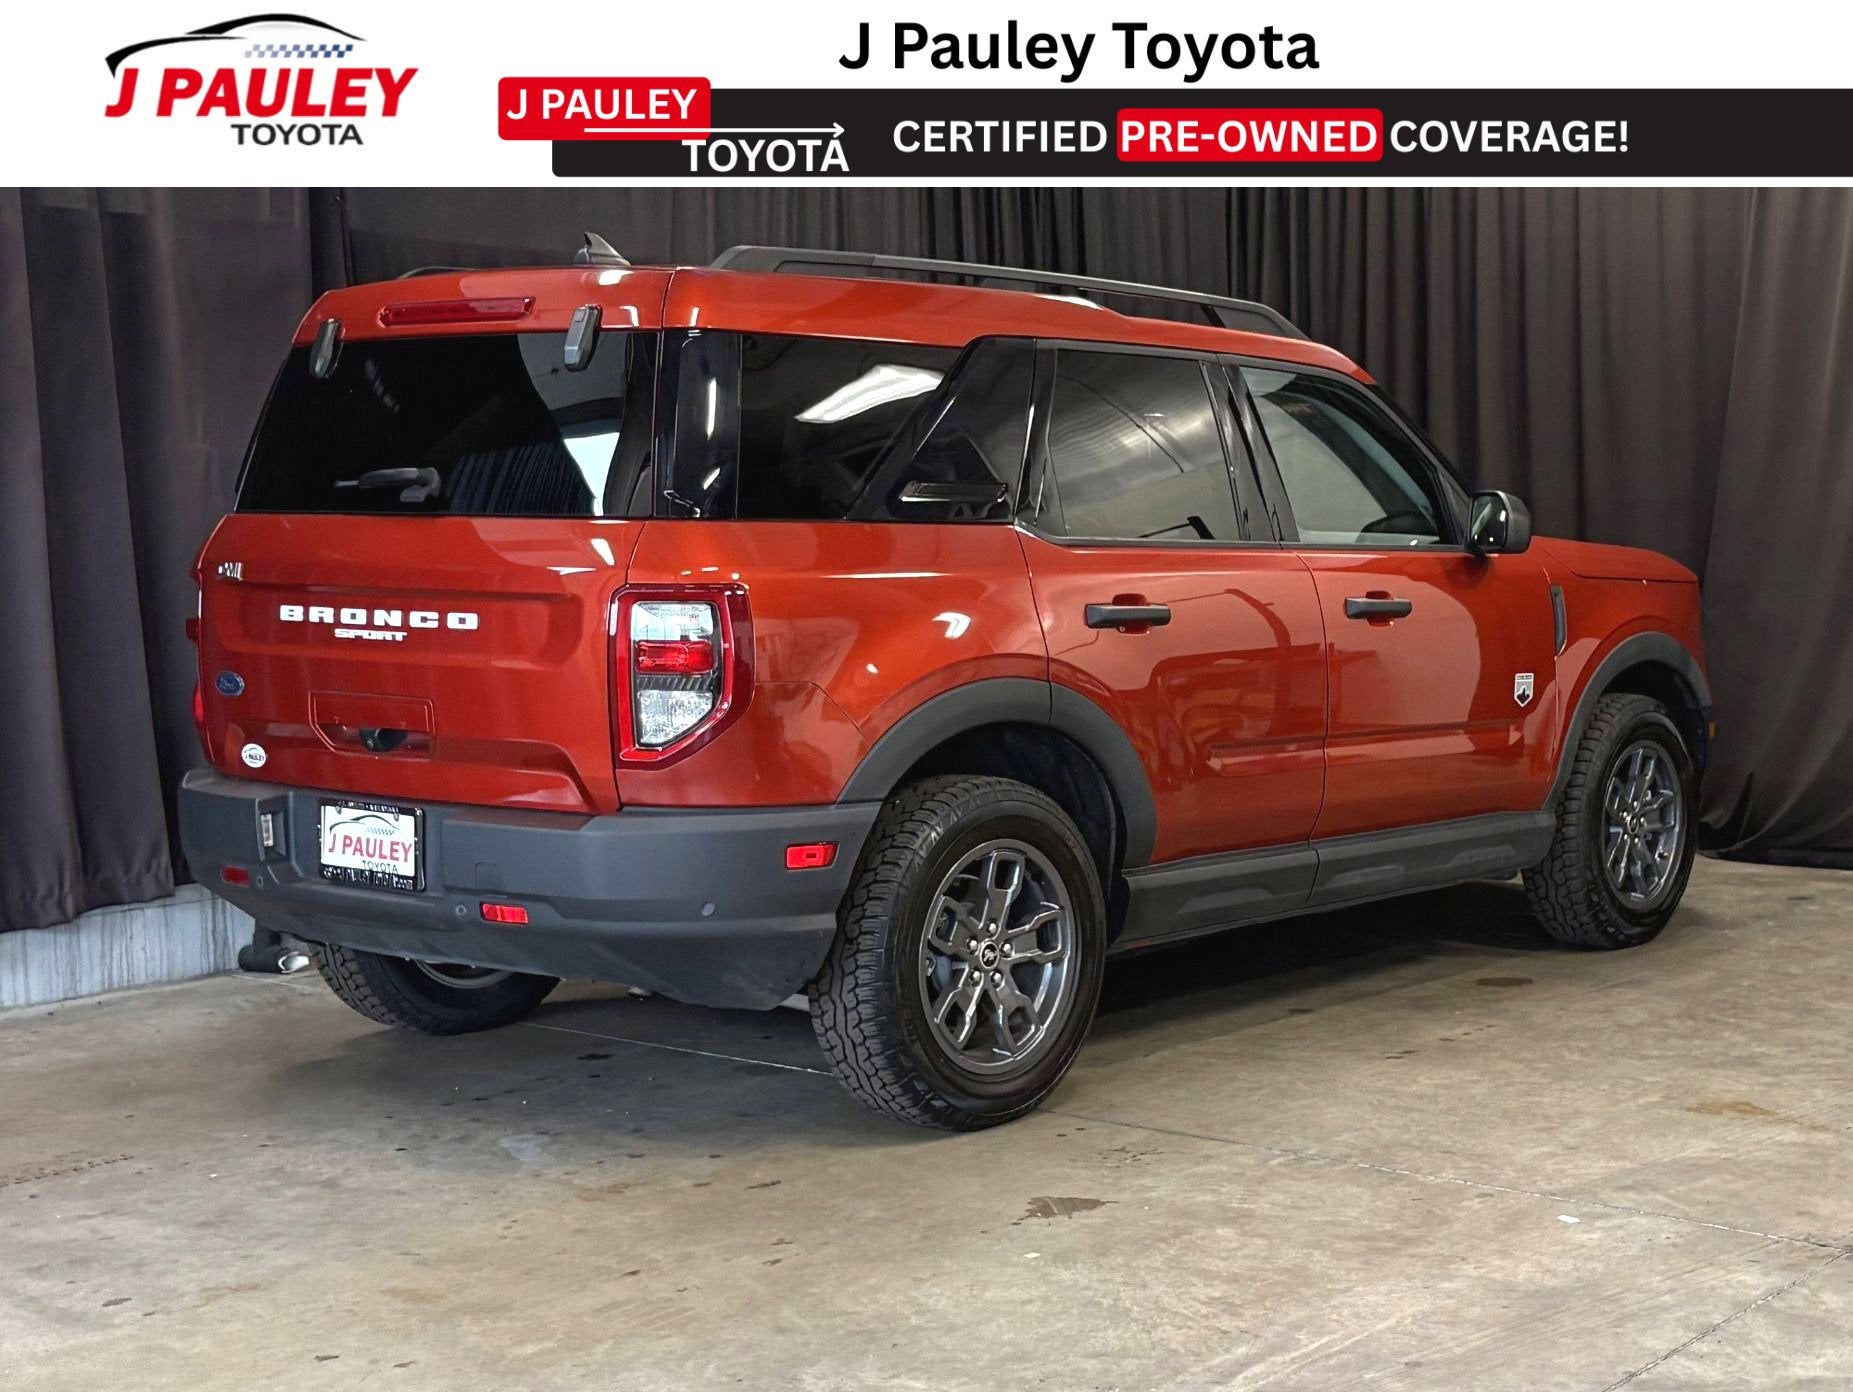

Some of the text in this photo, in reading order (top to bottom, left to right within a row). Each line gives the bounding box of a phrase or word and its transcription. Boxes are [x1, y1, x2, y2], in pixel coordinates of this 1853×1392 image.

[279, 604, 479, 631] BRONCO
[334, 628, 408, 642] SPORT
[328, 833, 413, 863] J PAULEY
[362, 860, 399, 875] TOYOTA
